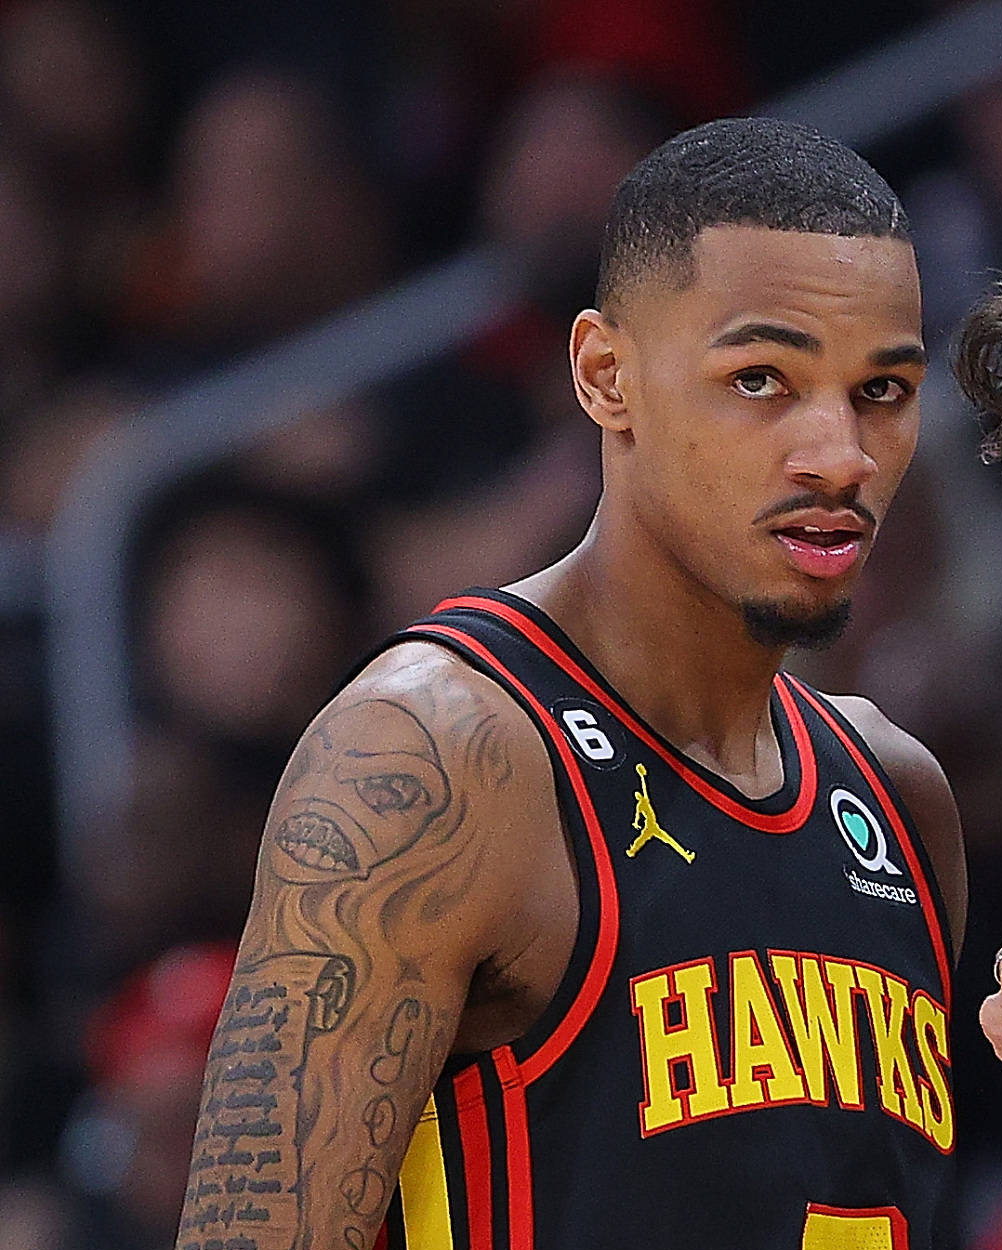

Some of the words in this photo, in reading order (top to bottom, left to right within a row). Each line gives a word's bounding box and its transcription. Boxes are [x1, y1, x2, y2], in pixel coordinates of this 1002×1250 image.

[562, 709, 615, 761] 6
[848, 870, 918, 904] sharecare
[629, 948, 956, 1154] HAWKS
